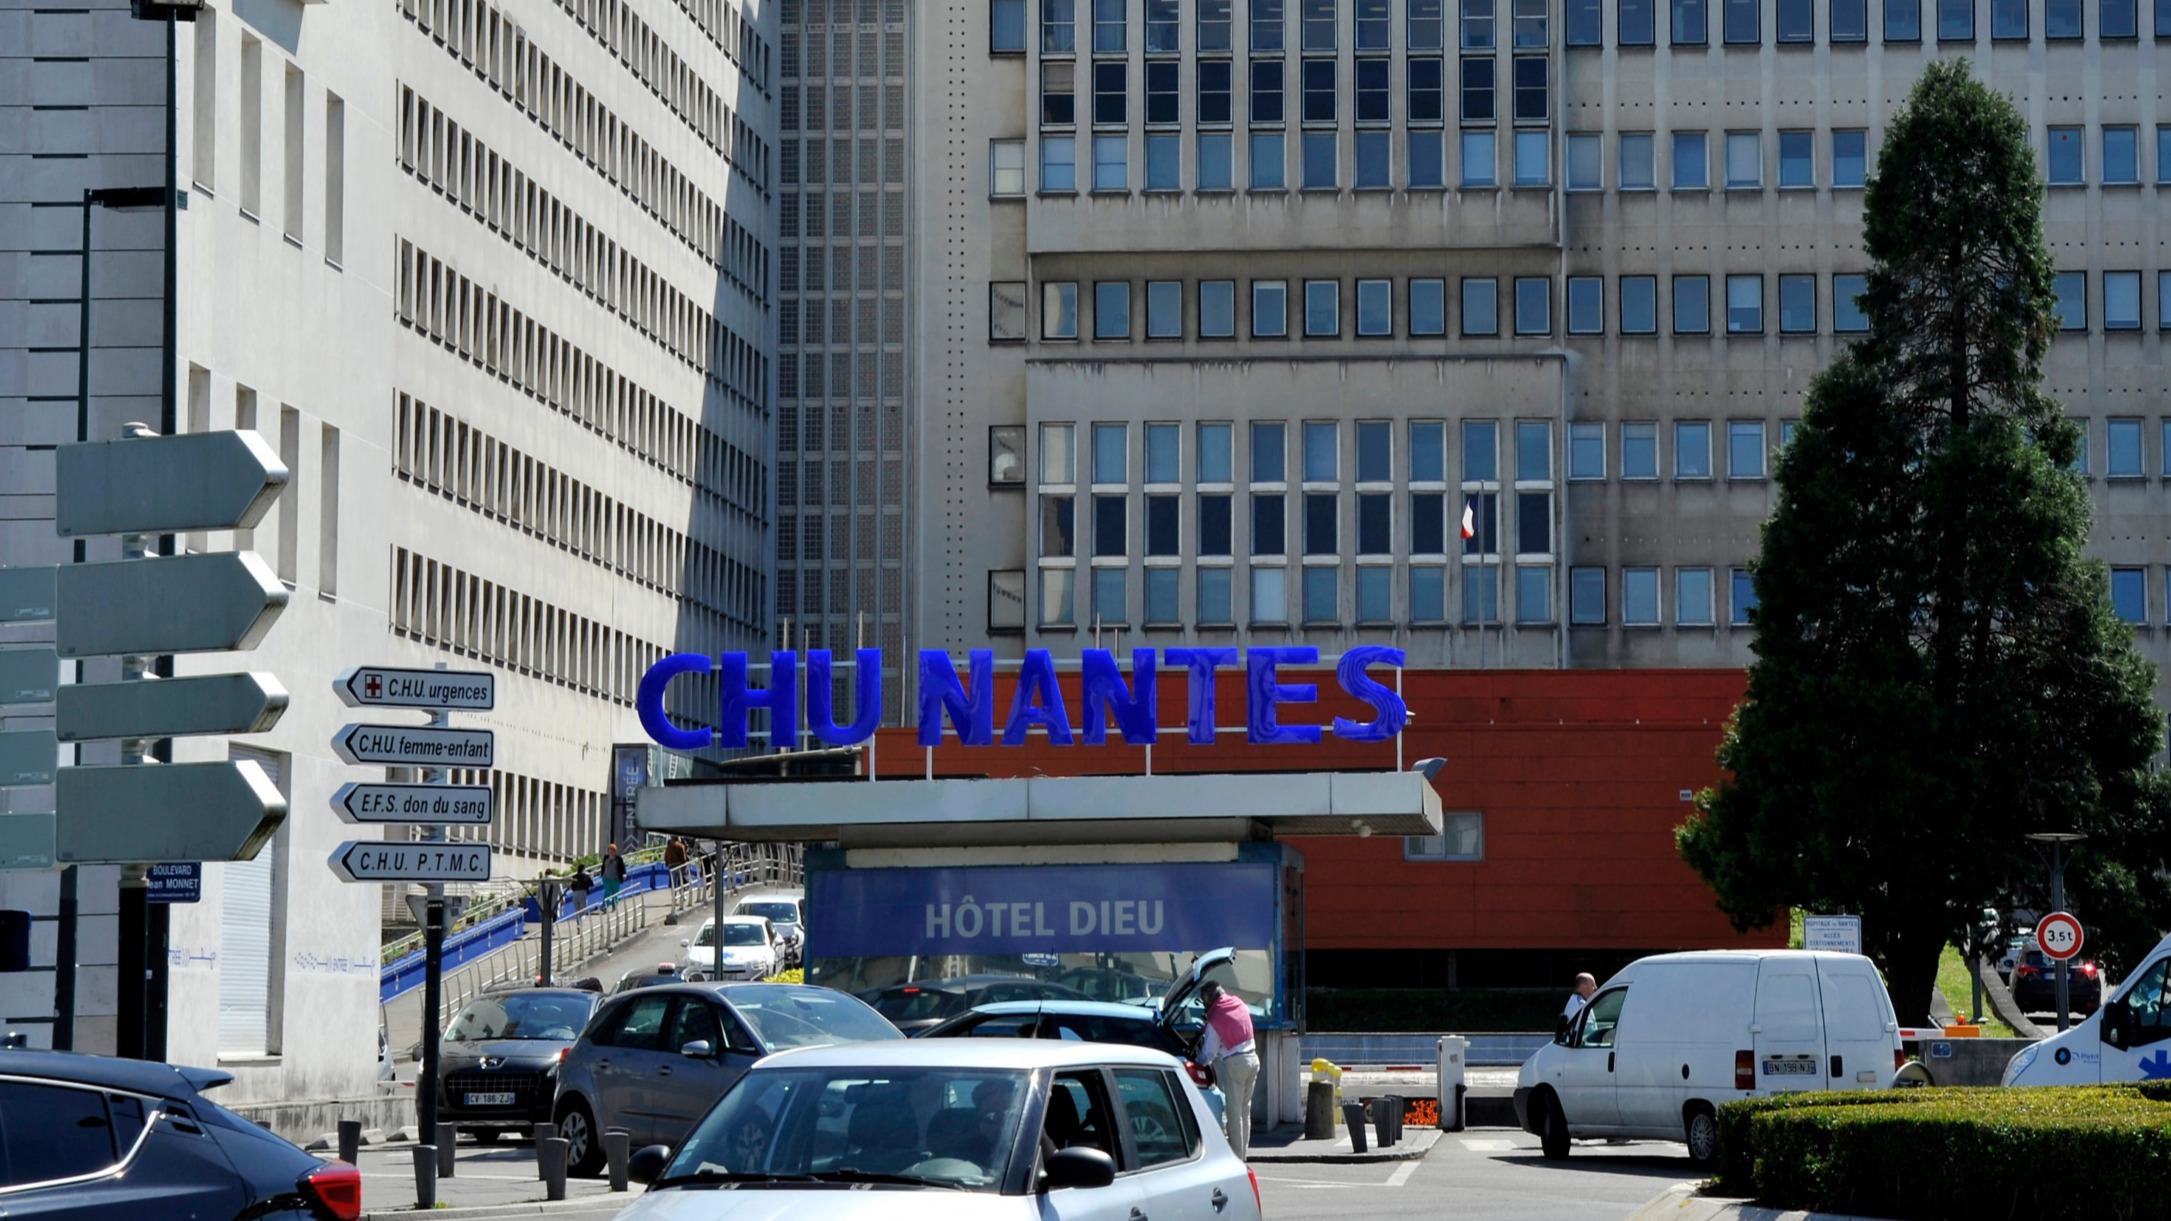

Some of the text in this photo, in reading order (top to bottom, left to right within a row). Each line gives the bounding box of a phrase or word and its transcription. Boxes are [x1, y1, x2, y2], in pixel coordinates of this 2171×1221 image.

[389, 679, 487, 704] C.H.U. urgences
[637, 646, 1407, 750] CHU NANTES
[359, 734, 489, 758] C.H.U. femme-enfant
[361, 794, 485, 819] E.F.S. don du sang
[153, 865, 192, 876] BOULEVARD
[360, 852, 484, 872] C.H.U. P.T.M.C.
[166, 878, 199, 889] MONNET
[926, 895, 1164, 939] HÔTEL DIEU
